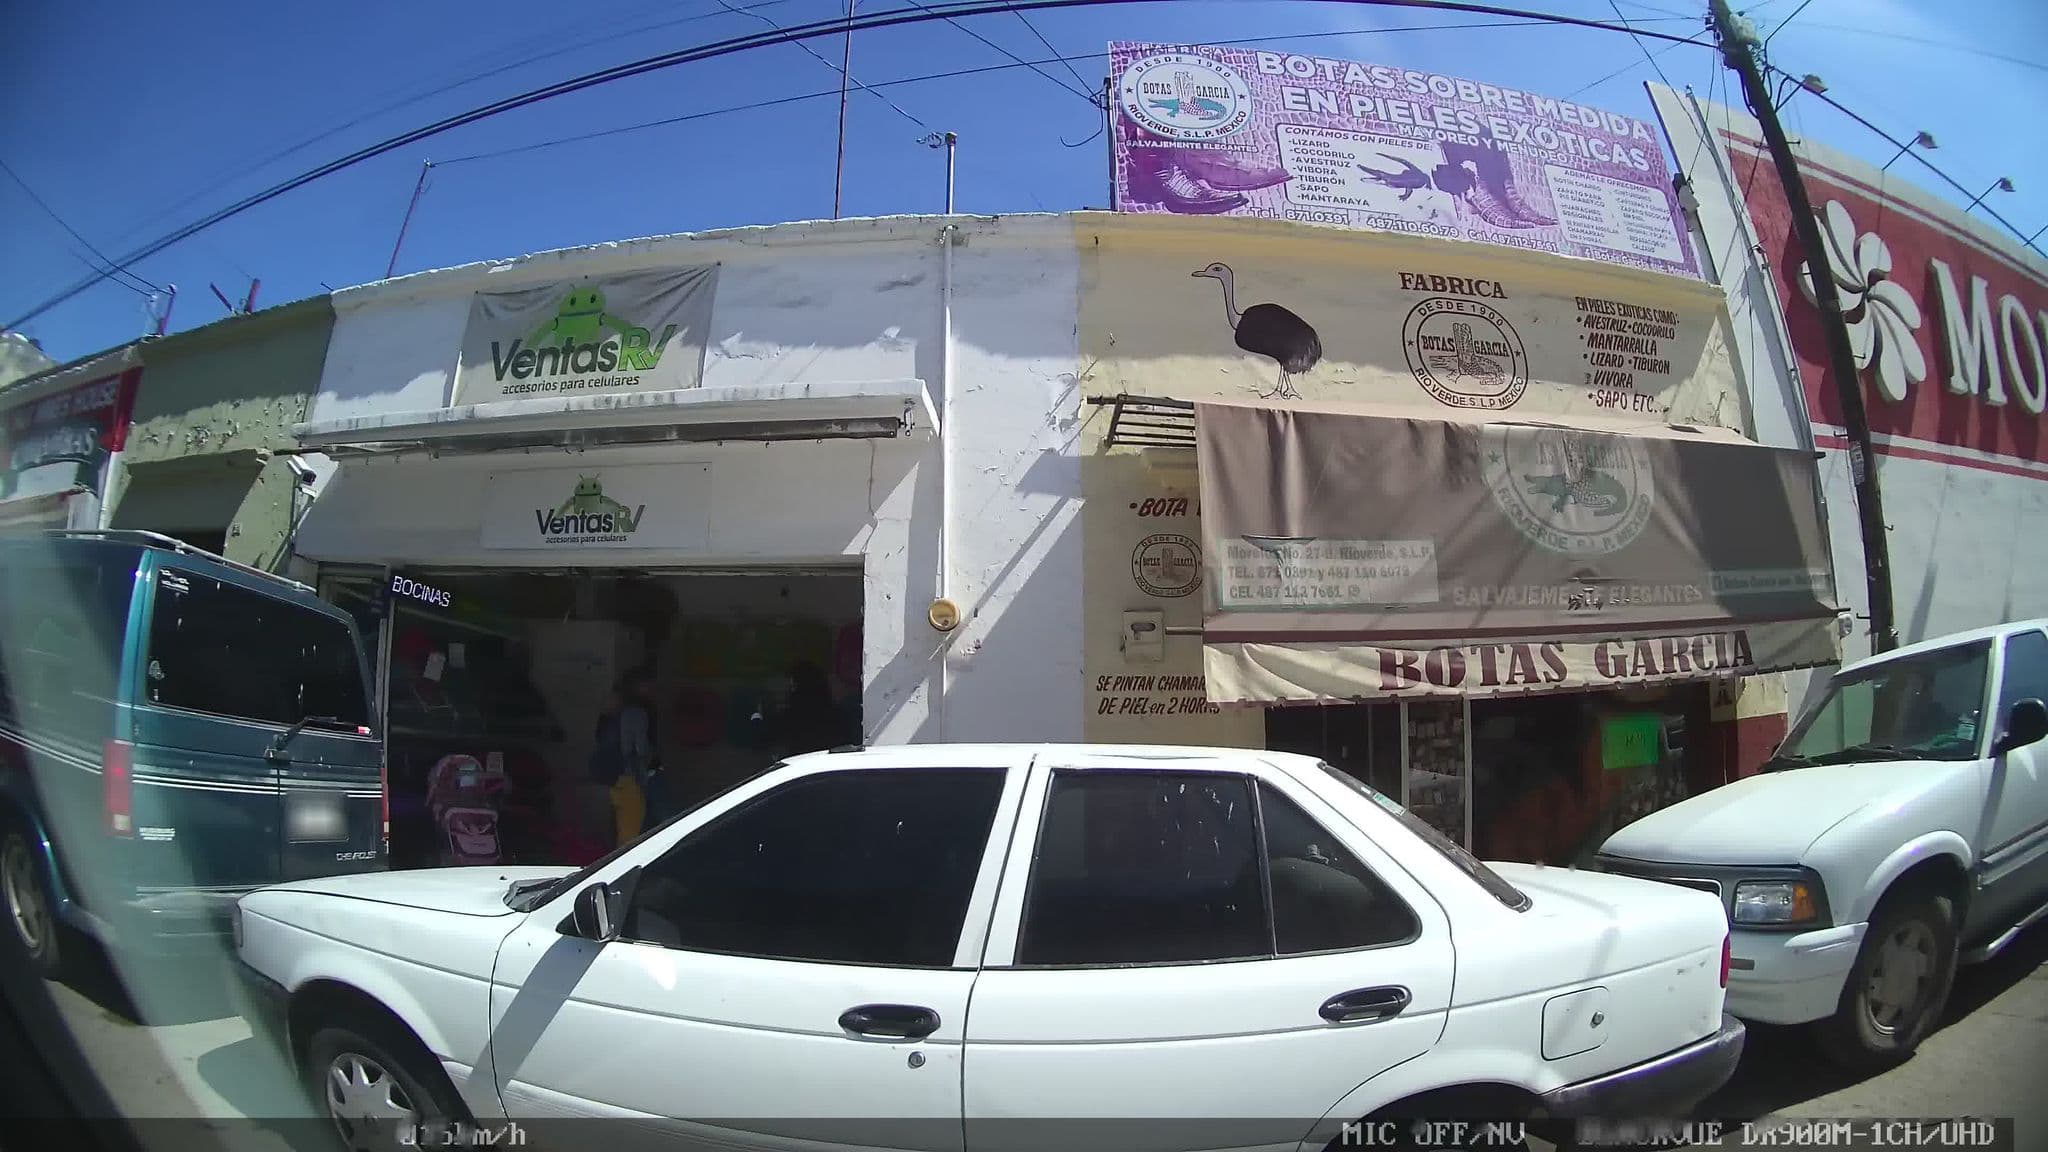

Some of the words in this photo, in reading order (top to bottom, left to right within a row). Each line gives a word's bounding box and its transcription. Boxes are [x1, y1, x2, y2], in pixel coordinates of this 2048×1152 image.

[1135, 56, 1183, 73] DESDE
[1197, 59, 1231, 78] 1900
[1143, 82, 1172, 95] BOTAS
[1255, 51, 1396, 89] BOTAS
[1404, 71, 1526, 113] SOBRE
[1531, 94, 1654, 144] MEDIDA
[1281, 85, 1340, 115] EN
[1349, 94, 1480, 135] PIELES
[1215, 111, 1247, 136] MEXICO
[1352, 134, 1376, 144] CON
[1378, 137, 1414, 148] PIELES
[1400, 124, 1479, 147] MAYOREO
[1482, 138, 1492, 149] Y
[1497, 139, 1568, 163] MENUDEO
[1250, 207, 1280, 219] Tel.
[1285, 209, 1349, 225] 871.0391
[1398, 272, 1508, 299] FABRICA
[1418, 300, 1464, 318] DESDE
[1471, 304, 1503, 327] 1900
[1587, 298, 1616, 316] PIELES
[1616, 302, 1654, 322] EXOTICAS
[1584, 314, 1628, 333] AVESTRUZ
[1632, 321, 1675, 340] COCODRILO
[1931, 256, 2048, 415] MO
[1421, 335, 1455, 353] BOTAS
[1474, 340, 1510, 358] GARCIA
[1587, 332, 1657, 356] MANTARRALLA
[1590, 351, 1624, 368] LIZARD
[1633, 356, 1670, 375] TIBURON
[502, 379, 557, 395] accesorios
[560, 379, 585, 393] para
[588, 375, 640, 388] celulares
[1593, 370, 1633, 388] VIVORA
[1498, 376, 1524, 407] MEXICO
[1596, 389, 1628, 410] SAPO
[1633, 394, 1657, 413] ETC.
[1137, 498, 1189, 517] BOTA
[580, 535, 596, 544] para
[392, 575, 451, 607] BOCINAS
[1376, 640, 1569, 691] BOTAS
[1594, 629, 1754, 679] GARCIA
[1096, 675, 1107, 692] SE
[1112, 675, 1154, 692] PINTAN
[1098, 697, 1117, 715] DE
[1119, 697, 1151, 715] PIEL
[1150, 701, 1165, 715] en
[1167, 698, 1176, 715] 2
